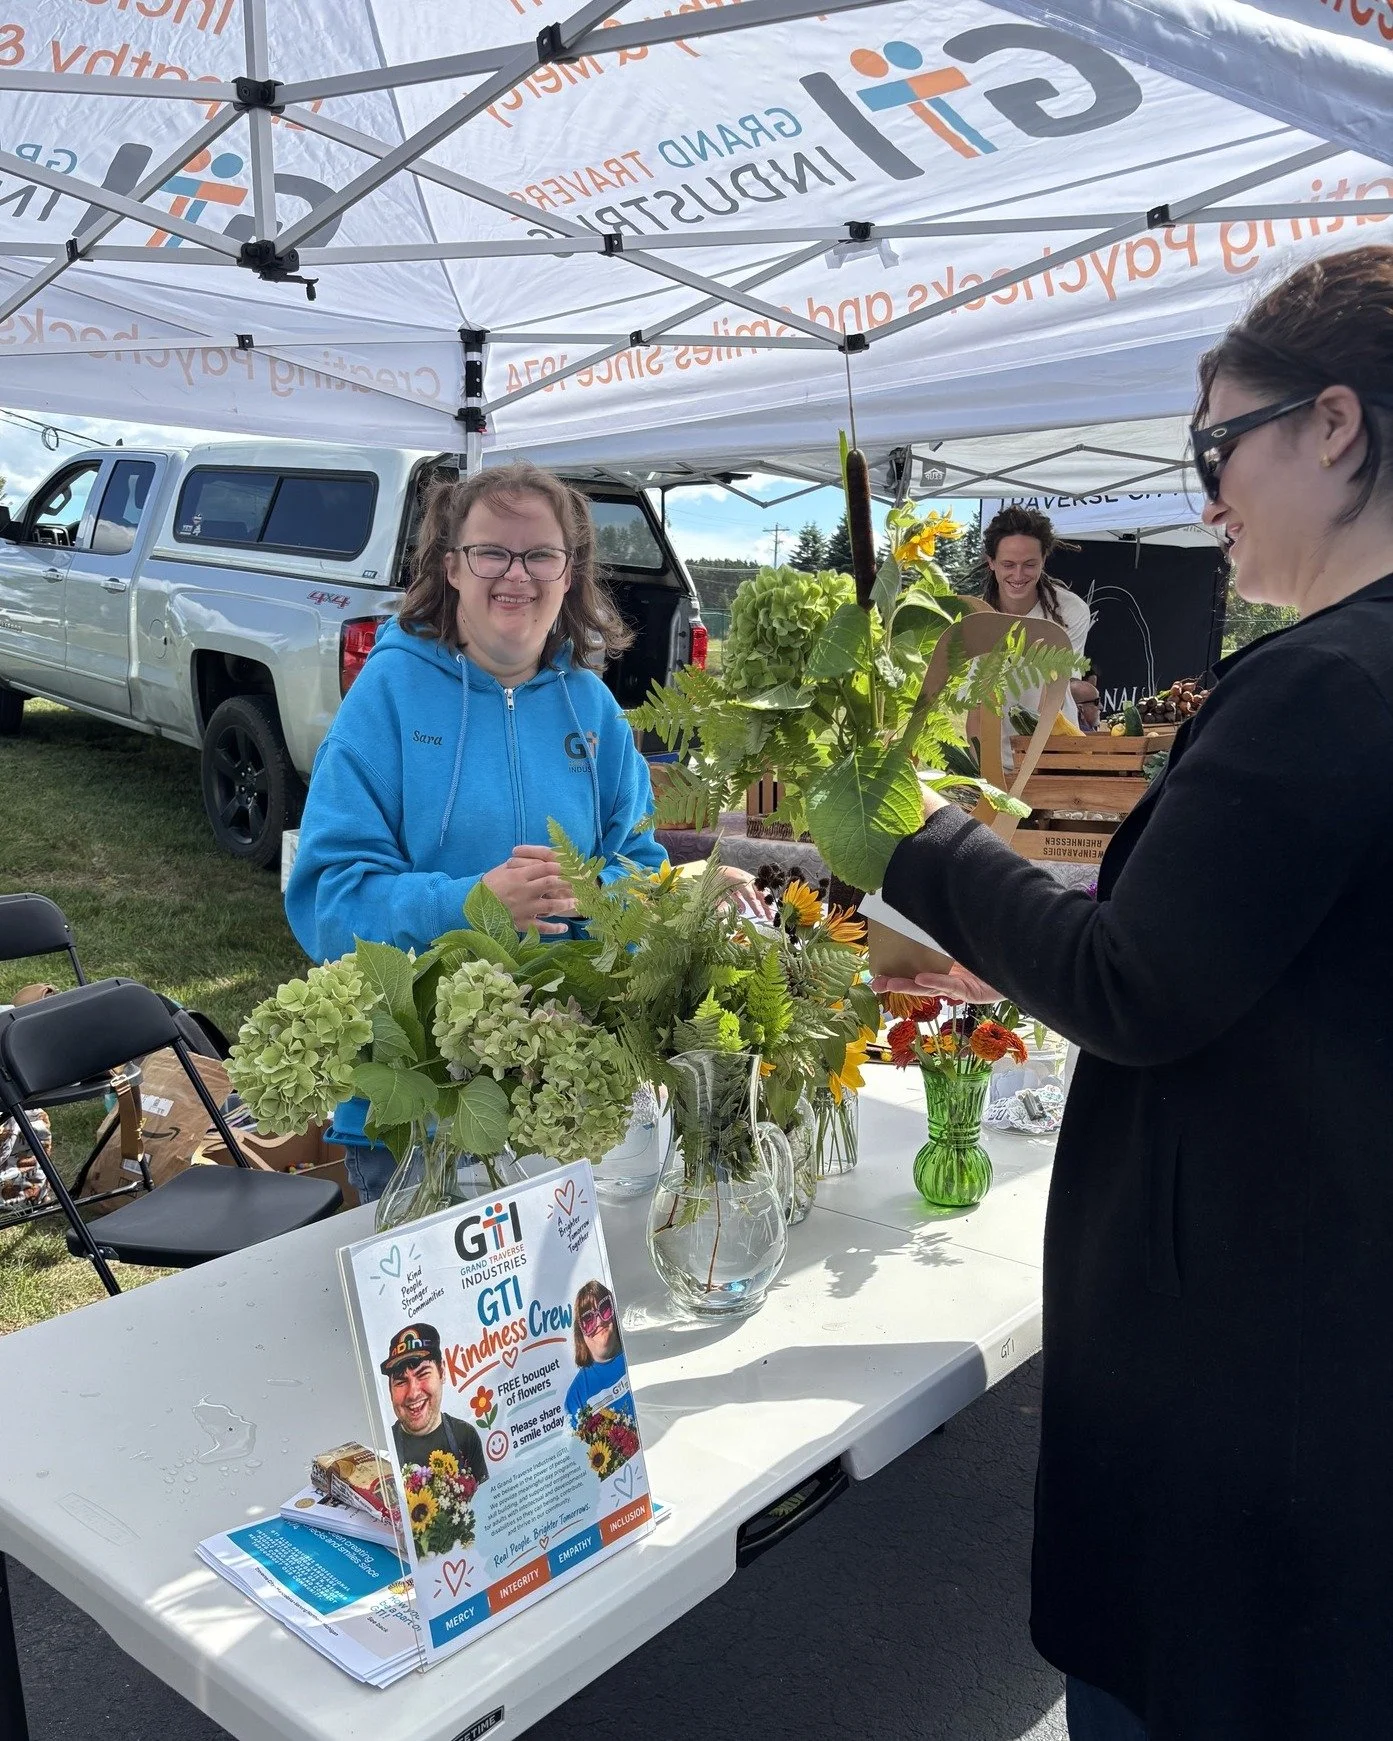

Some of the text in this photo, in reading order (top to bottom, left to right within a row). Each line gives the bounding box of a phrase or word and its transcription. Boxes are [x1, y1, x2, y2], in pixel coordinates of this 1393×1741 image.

[412, 730, 443, 746] Sara
[1045, 837, 1102, 847] RHEINHESSEN
[454, 1201, 523, 1261] GTI
[557, 1216, 562, 1226] A
[557, 1215, 581, 1237] Brighter
[565, 1219, 589, 1241] Tomorrow
[567, 1231, 588, 1253] Together
[460, 1243, 524, 1275] GRAND TRAVERSE
[461, 1253, 526, 1288] INDUSTRIES
[406, 1265, 421, 1282] Kind
[400, 1279, 423, 1297] People
[401, 1285, 431, 1310] Stronger
[477, 1275, 522, 1326] GTI
[405, 1288, 444, 1317] Communities
[445, 1300, 574, 1385] Kindness Crew
[497, 1359, 559, 1396] FREE bouquet
[506, 1378, 551, 1406] of flowers
[510, 1405, 561, 1436] Please share
[512, 1415, 564, 1448] a smile today
[496, 1477, 512, 1489] Grand
[512, 1466, 532, 1480] Traverse
[532, 1454, 556, 1469] Industries
[501, 1483, 518, 1495] believe
[533, 1467, 548, 1479] power
[487, 1510, 497, 1520] skill
[528, 1480, 552, 1497] supported
[552, 1465, 581, 1484] employment
[492, 1515, 507, 1526] adults
[507, 1508, 518, 1517] with
[518, 1493, 544, 1511] intellectual
[553, 1470, 586, 1492] developmental
[498, 1492, 517, 1506] provide
[517, 1477, 543, 1495] meaningful
[544, 1472, 553, 1480] day
[490, 1519, 515, 1536] disabilities
[522, 1509, 533, 1518] they
[493, 1503, 590, 1567] Real People. Brighter Tomorrows.
[516, 1519, 530, 1530] thrive
[324, 1538, 342, 1548] and
[337, 1546, 361, 1563] smiles
[358, 1561, 379, 1577] since
[344, 1540, 374, 1563] creating
[445, 1505, 645, 1630] MERCY INTEGRITY EMPATHY INCLUSION
[392, 1611, 413, 1625] part
[458, 1714, 496, 1741] ETIME
